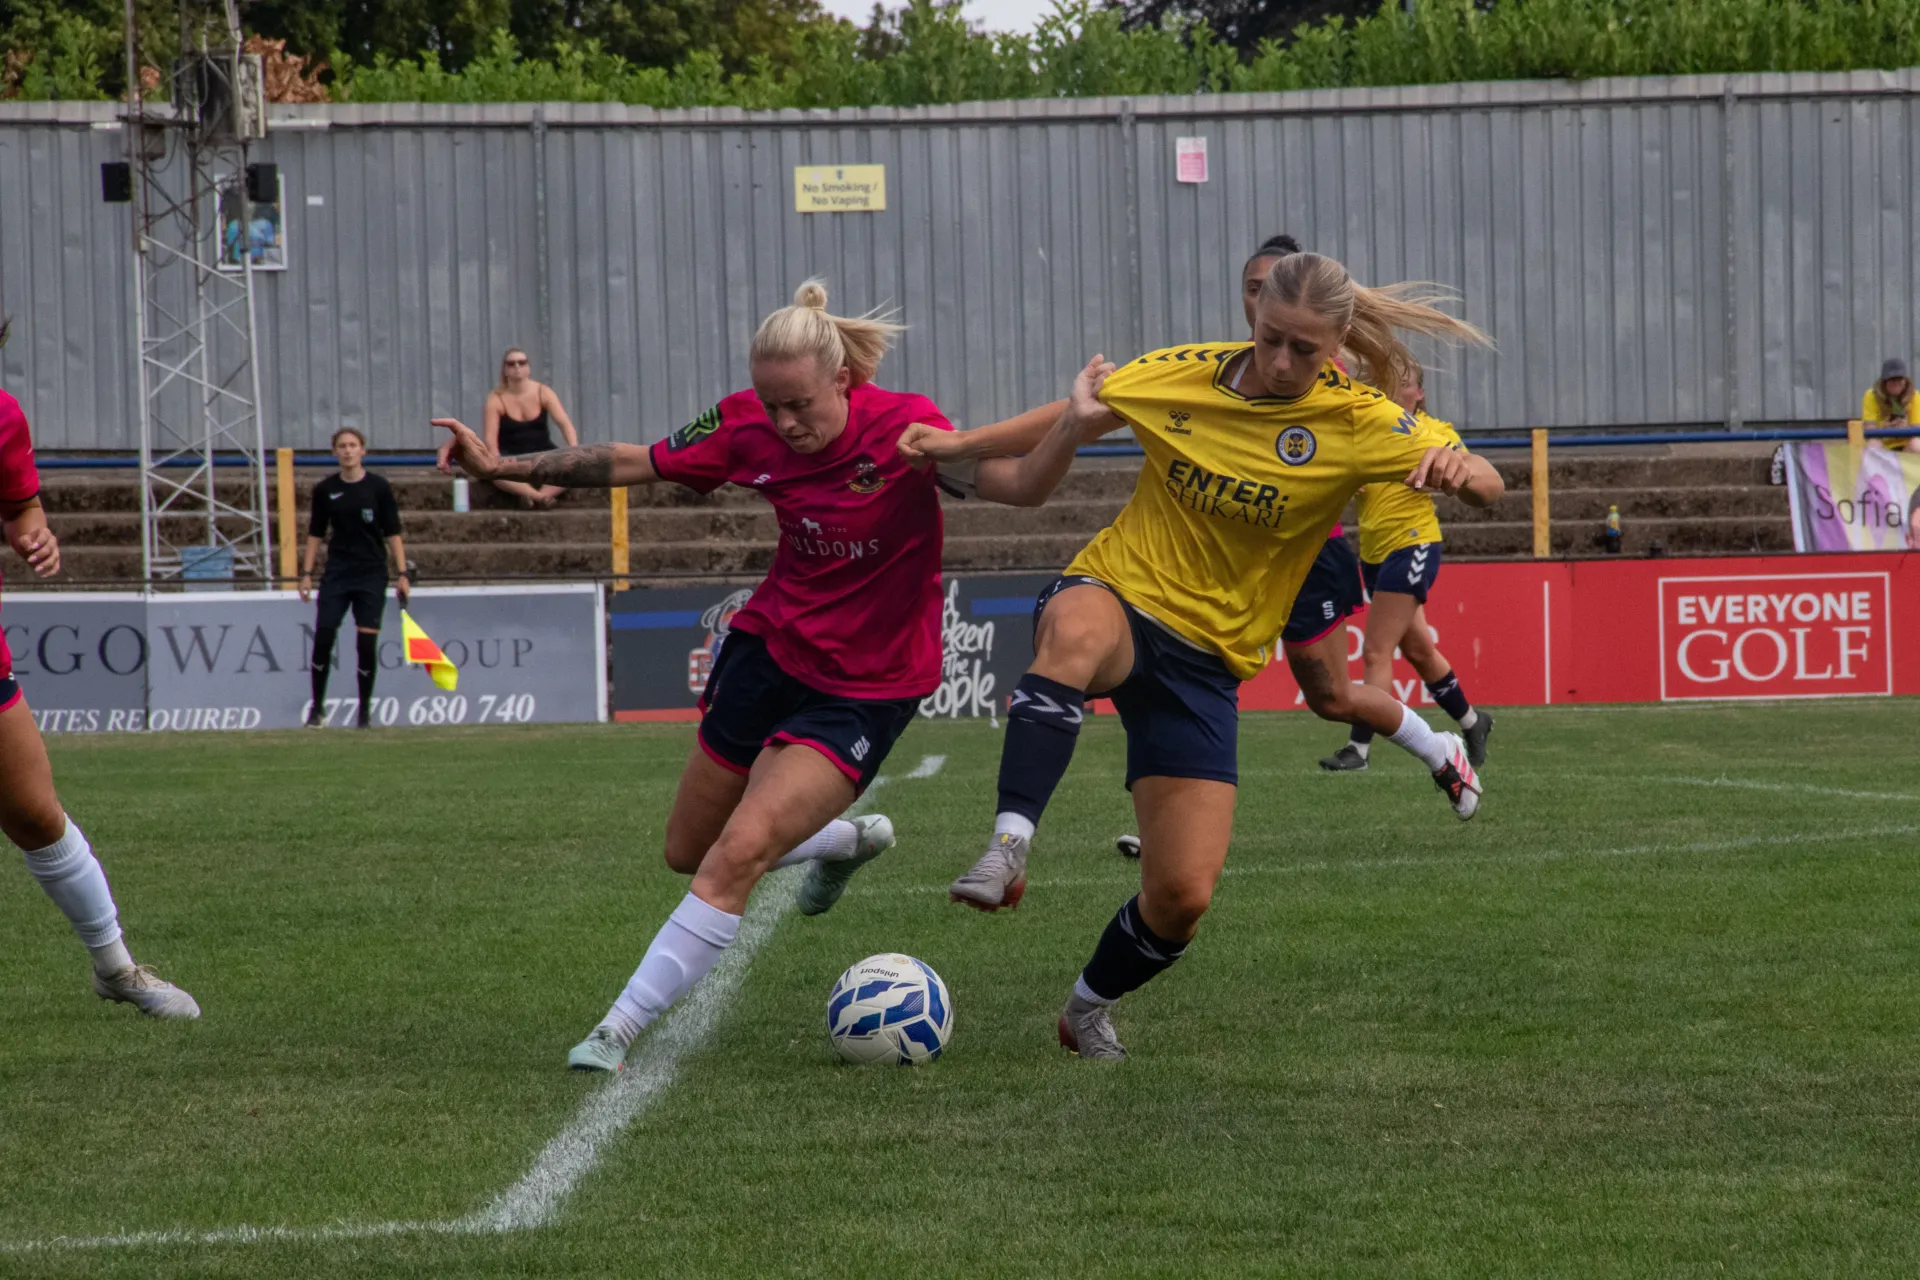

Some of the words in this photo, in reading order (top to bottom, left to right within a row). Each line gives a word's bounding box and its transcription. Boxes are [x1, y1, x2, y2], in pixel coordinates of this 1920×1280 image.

[802, 184, 819, 193] No
[822, 182, 871, 193] Smoking
[812, 197, 829, 205] No
[831, 196, 869, 207] Vaping
[1167, 459, 1289, 511] ENTER:
[1165, 479, 1285, 528] SHIKARI
[1815, 485, 1902, 527] Sofia
[1677, 591, 1872, 625] EVERYONE
[378, 638, 534, 671] GOUP
[1677, 626, 1872, 683] GOLF
[408, 694, 468, 724] 680
[478, 692, 535, 723] 740
[919, 658, 998, 727] eople
[860, 968, 899, 978] uhlsport
